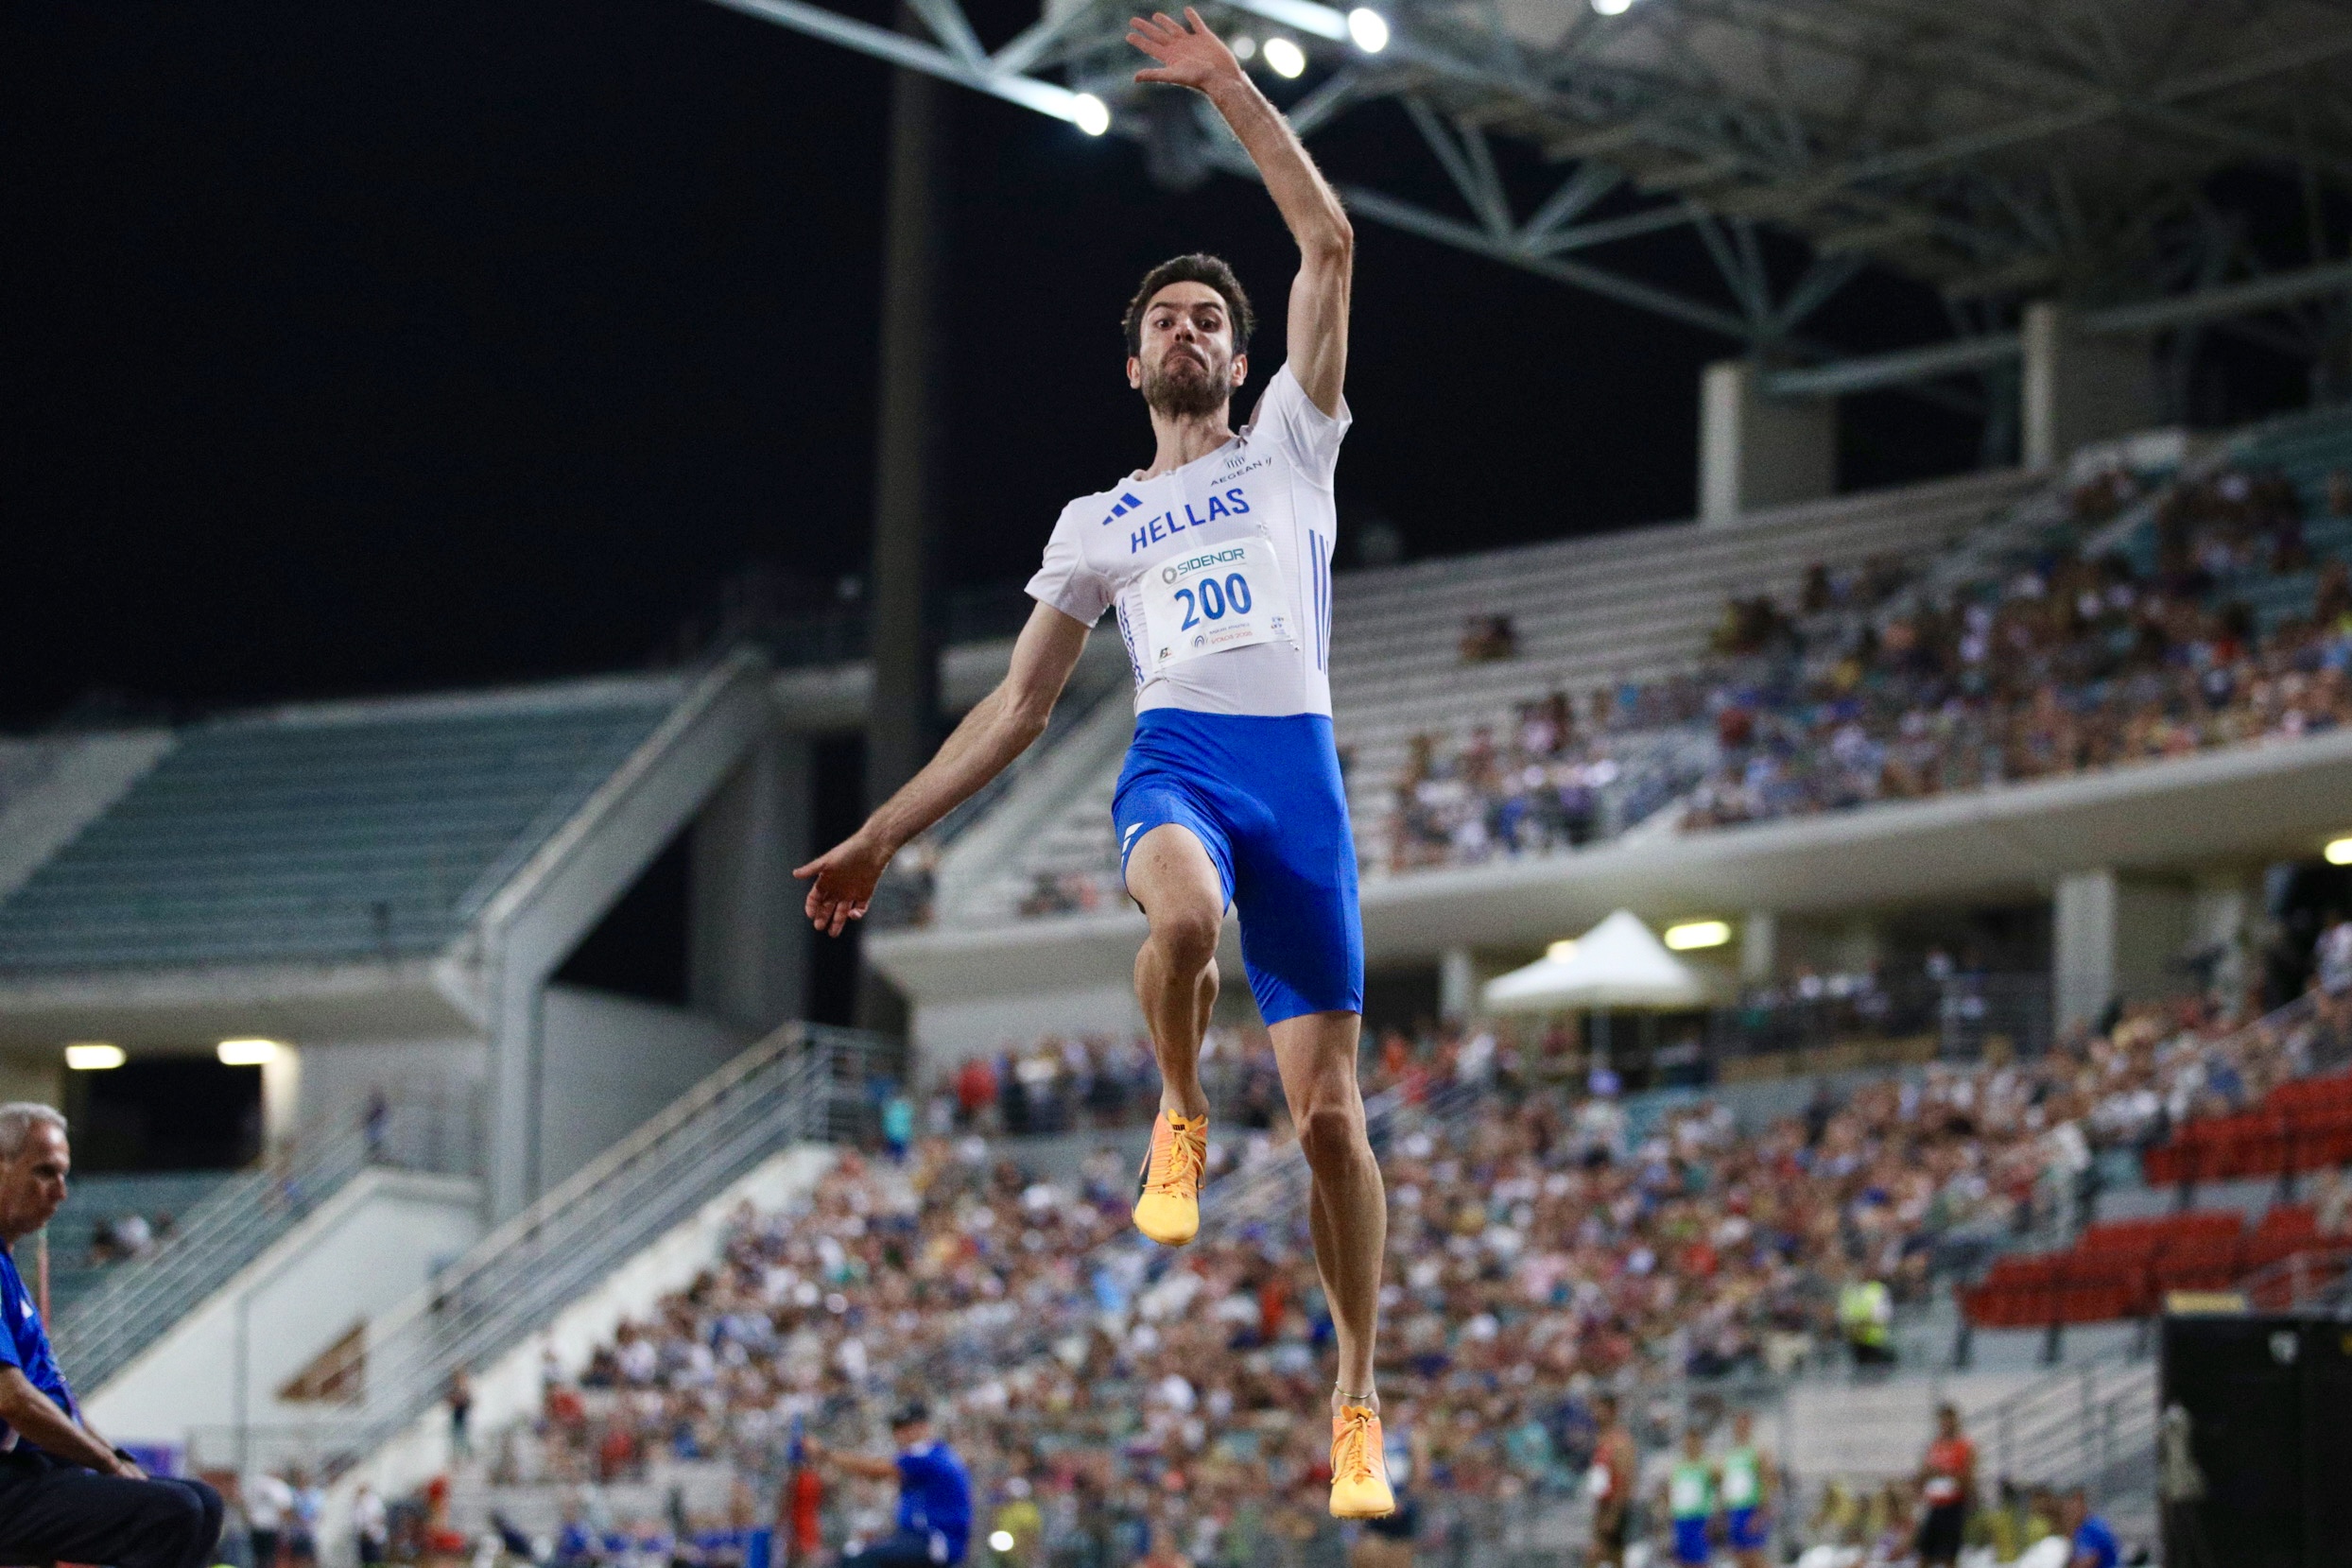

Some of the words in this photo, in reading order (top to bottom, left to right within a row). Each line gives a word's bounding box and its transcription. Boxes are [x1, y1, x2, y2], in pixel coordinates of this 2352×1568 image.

[1210, 460, 1262, 487] AEGEAN
[1131, 488, 1250, 554] HELLAS
[1177, 548, 1246, 576] SIDENOR
[1174, 573, 1252, 632] 200
